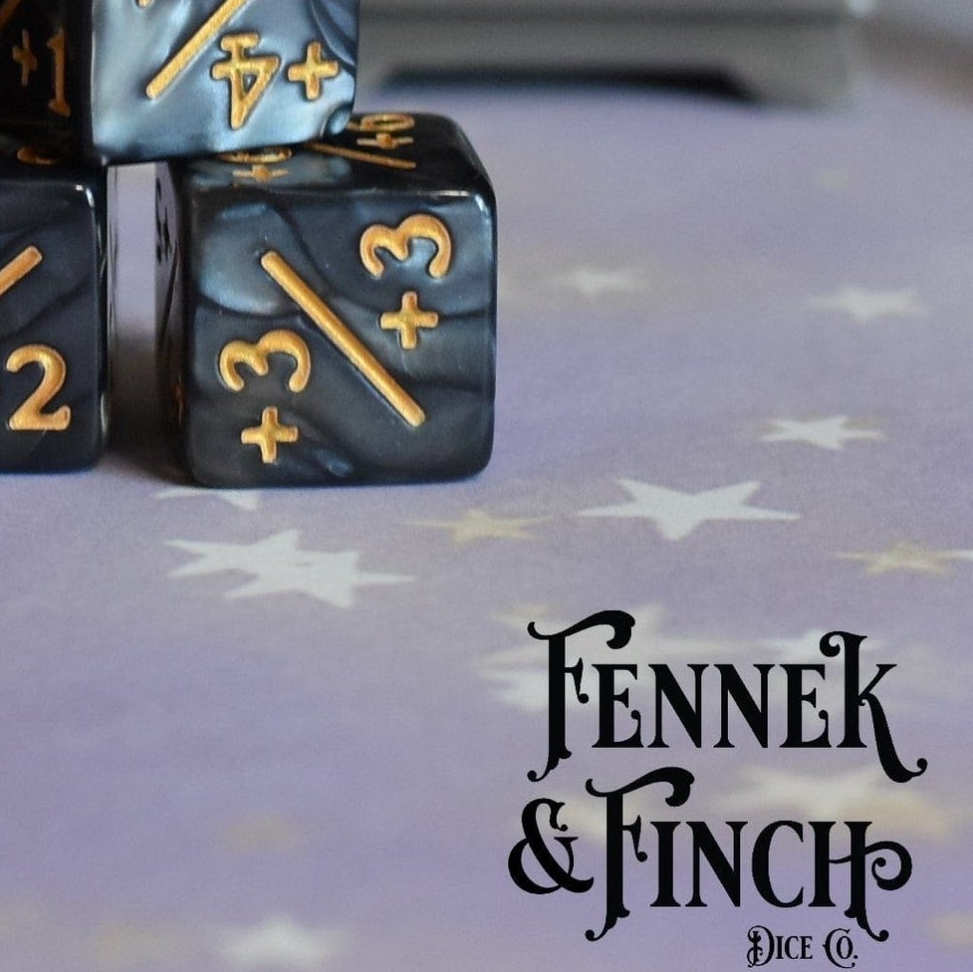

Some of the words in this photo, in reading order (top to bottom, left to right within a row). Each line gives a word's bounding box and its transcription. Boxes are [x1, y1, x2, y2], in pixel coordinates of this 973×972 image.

[12, 28, 72, 118] +1
[211, 32, 339, 130] +4
[359, 213, 452, 350] +3
[219, 329, 312, 464] +3
